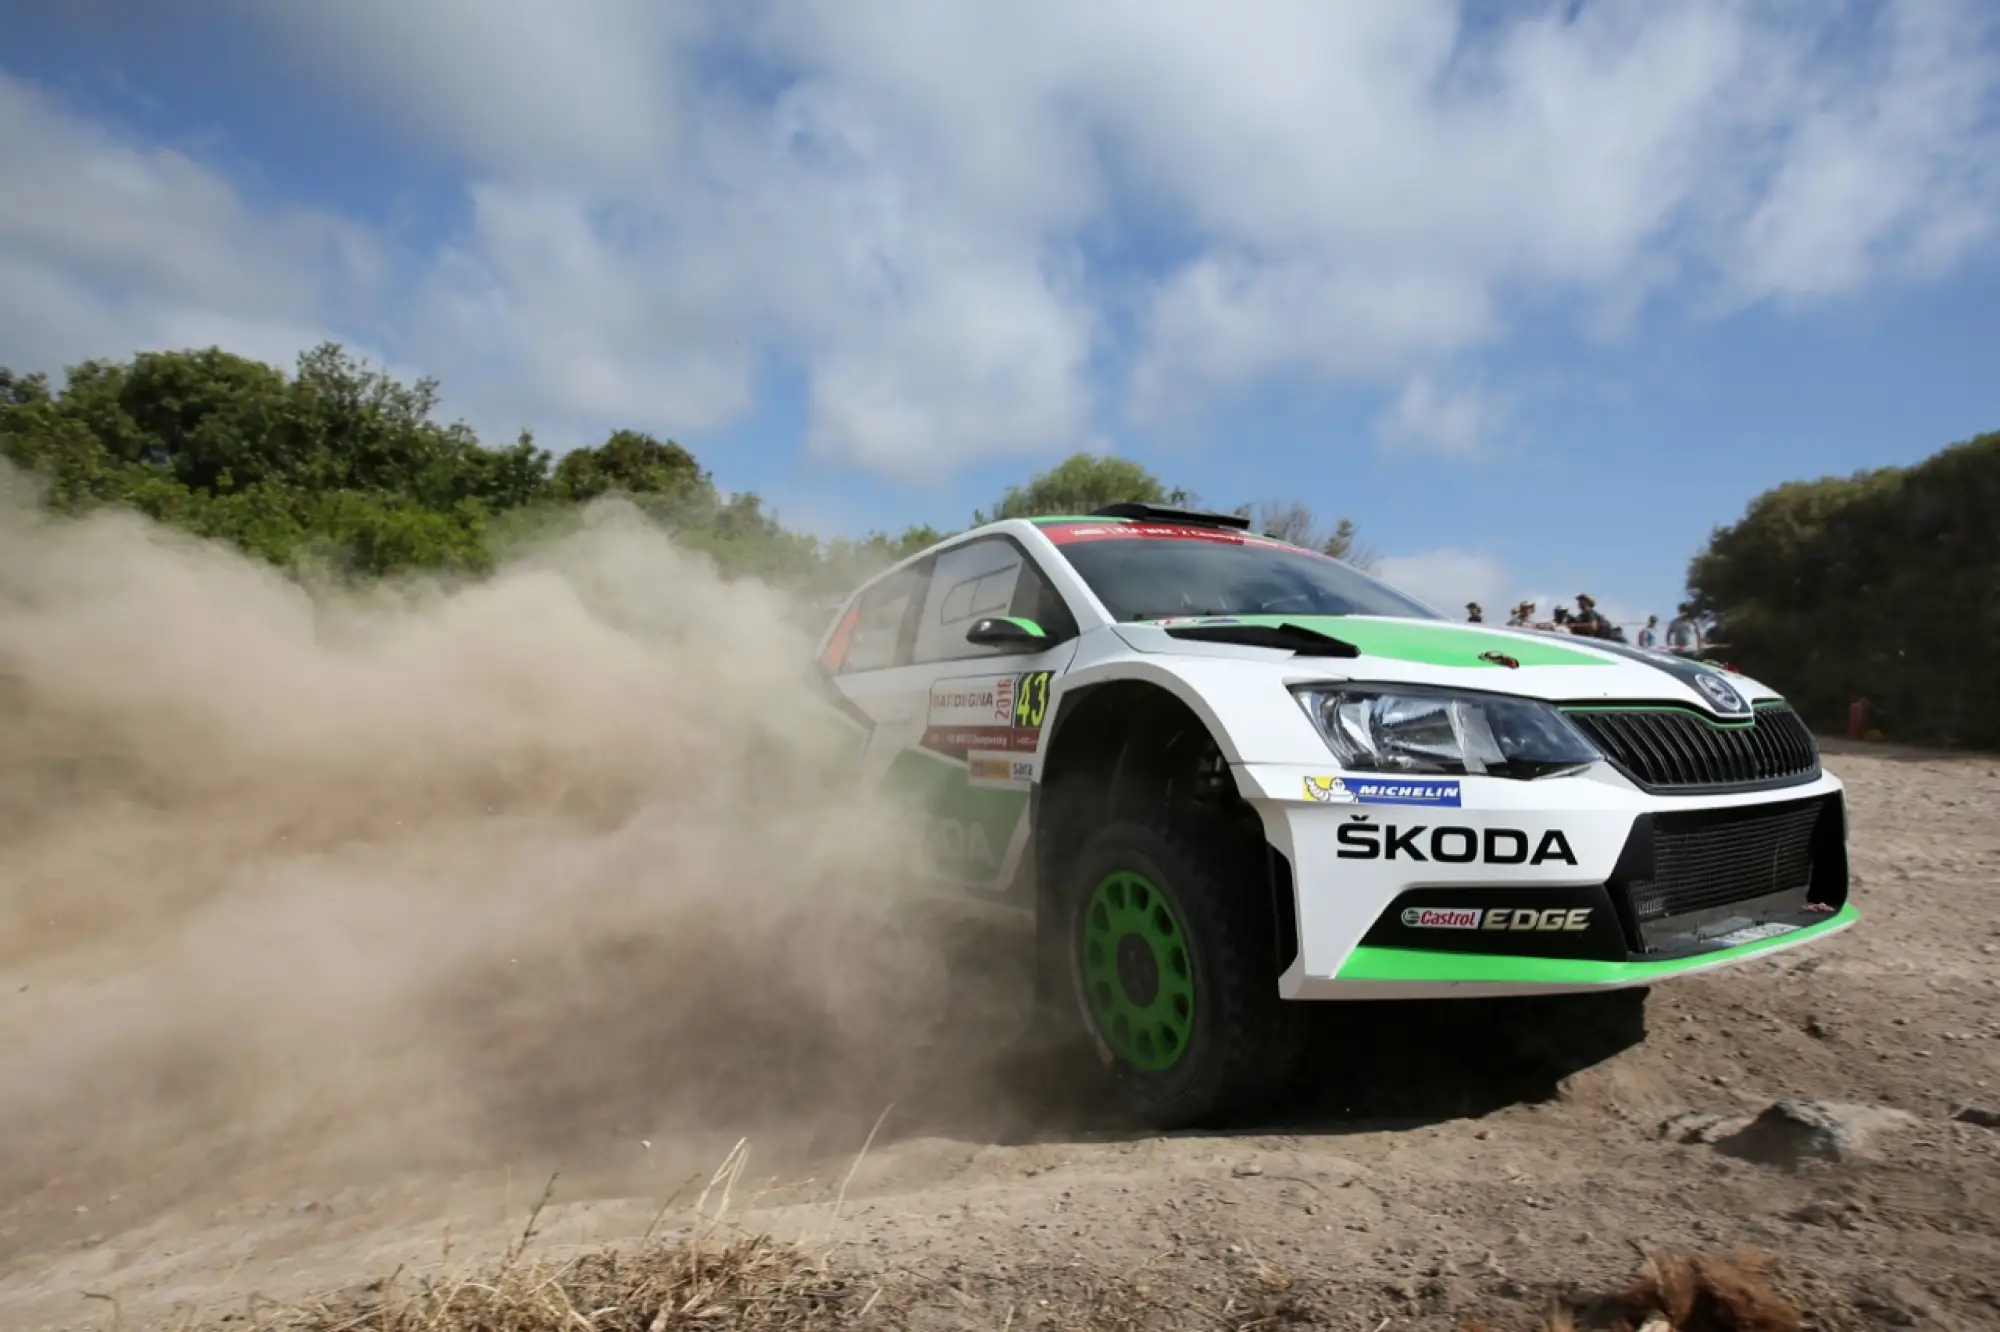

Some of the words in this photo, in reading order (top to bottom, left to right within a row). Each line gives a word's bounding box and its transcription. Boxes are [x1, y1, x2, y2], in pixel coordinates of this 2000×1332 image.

[994, 679, 1012, 721] 2016
[1017, 672, 1048, 727] 43
[1358, 785, 1459, 798] MICHELIN
[1336, 814, 1579, 866] ŠKODA
[1419, 910, 1477, 927] Castrol
[1480, 908, 1594, 932] EDGE
